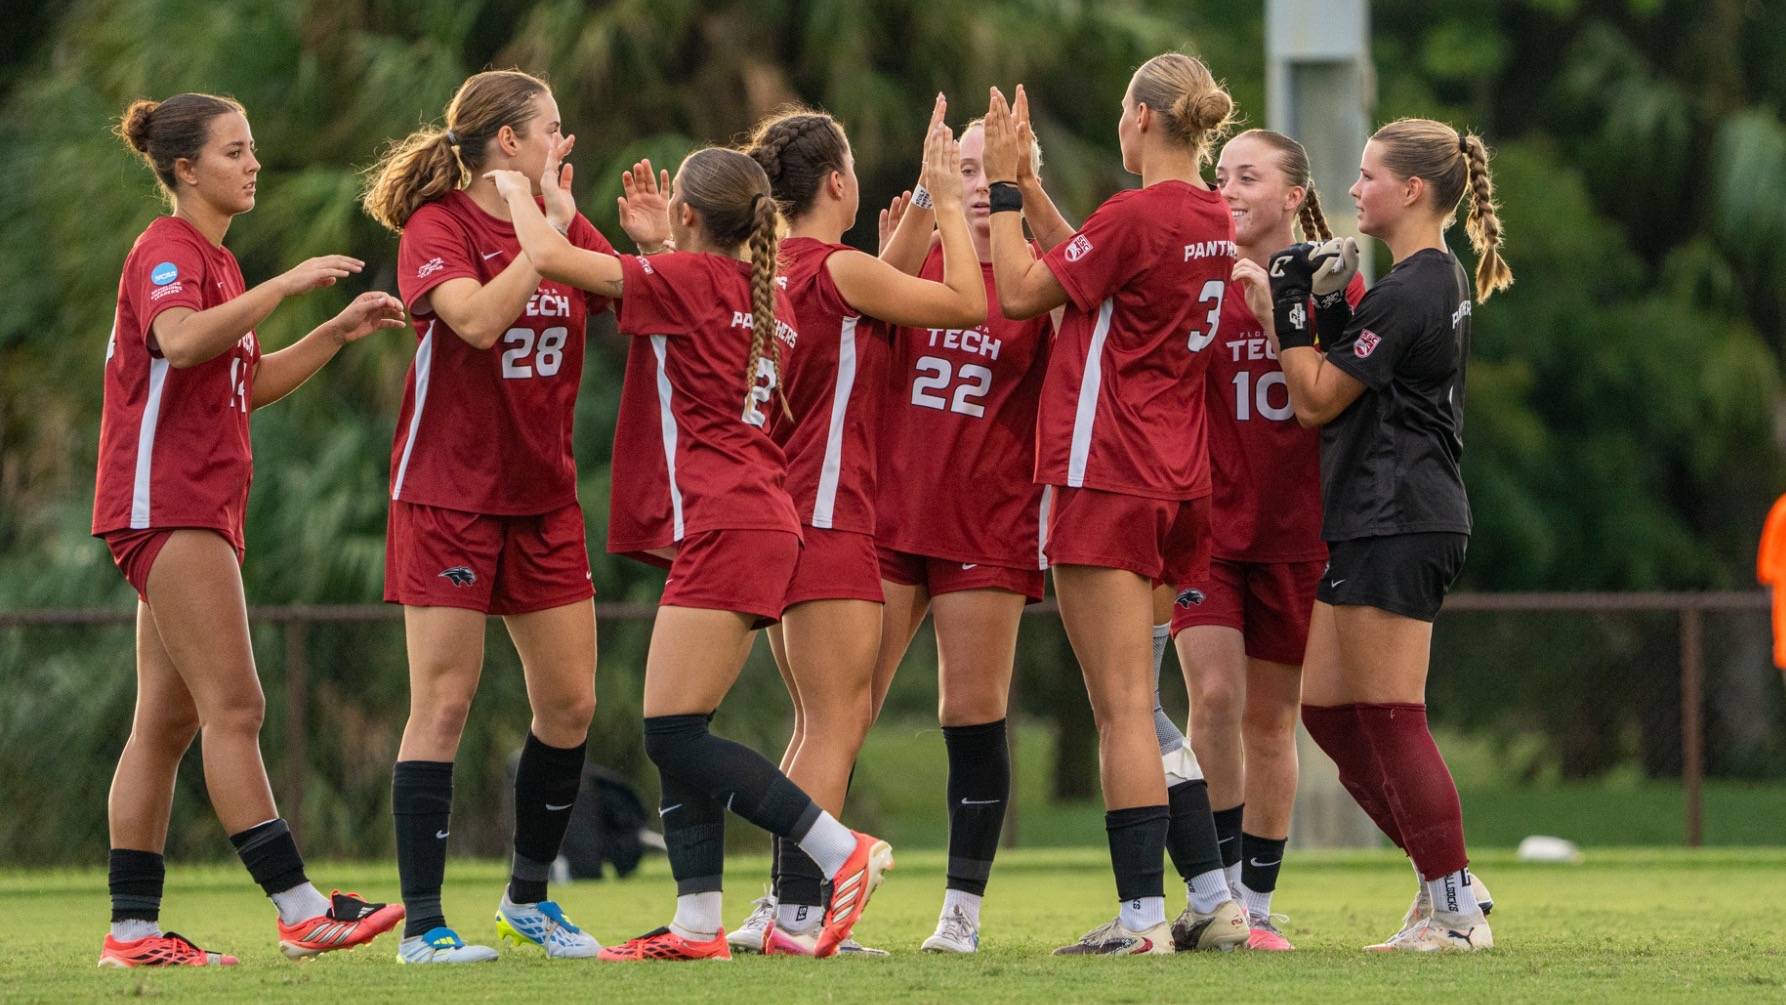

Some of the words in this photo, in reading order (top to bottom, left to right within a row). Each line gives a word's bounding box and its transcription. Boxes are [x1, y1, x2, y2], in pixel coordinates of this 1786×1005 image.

[1077, 236, 1090, 251] SSC
[1184, 240, 1238, 262] PANTH
[526, 294, 570, 317] ECH
[1188, 280, 1225, 352] 3
[731, 311, 798, 349] PAHERS
[927, 328, 1001, 360] TECH
[502, 327, 568, 379] 28
[1226, 338, 1279, 362] TEC
[742, 357, 776, 428] 2
[911, 355, 993, 418] 22
[1232, 371, 1294, 421] 10
